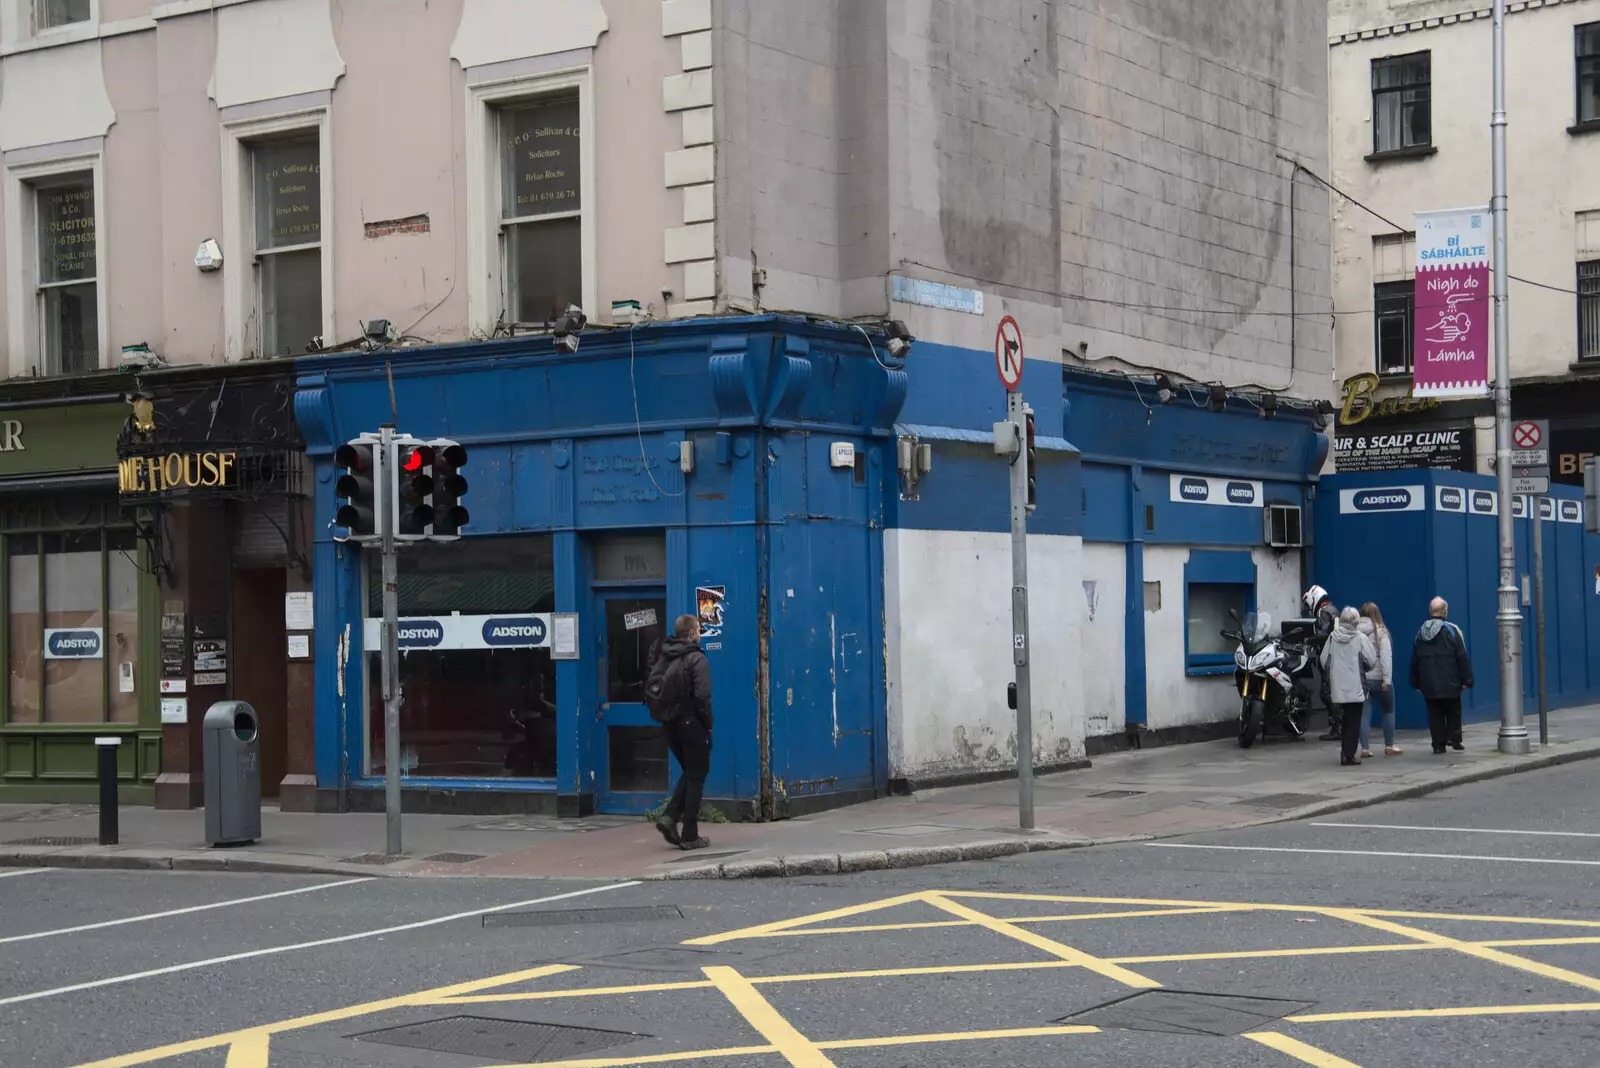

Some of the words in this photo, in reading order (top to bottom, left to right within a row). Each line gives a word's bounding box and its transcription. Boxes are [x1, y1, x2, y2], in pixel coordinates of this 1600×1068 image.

[535, 127, 563, 138] Sullivan
[529, 149, 561, 160] Solicitors
[1447, 234, 1459, 246] BÍ
[1420, 245, 1485, 260] SÁBHÁILTE
[1427, 276, 1459, 295] Nigh
[1463, 273, 1479, 289] do
[1427, 347, 1475, 362] Lámha
[0, 420, 26, 451] R
[1356, 437, 1367, 449] &
[1370, 433, 1413, 448] SCALP
[1415, 431, 1460, 445] CLINIC
[1183, 485, 1207, 495] ADSTON
[1230, 488, 1253, 498] ADSTON
[1362, 494, 1407, 505] ADSTON
[1443, 494, 1460, 504] ADSTON
[1475, 497, 1492, 507] ADSTON
[491, 626, 542, 638] ADSTON
[56, 638, 96, 649] ADSTON
